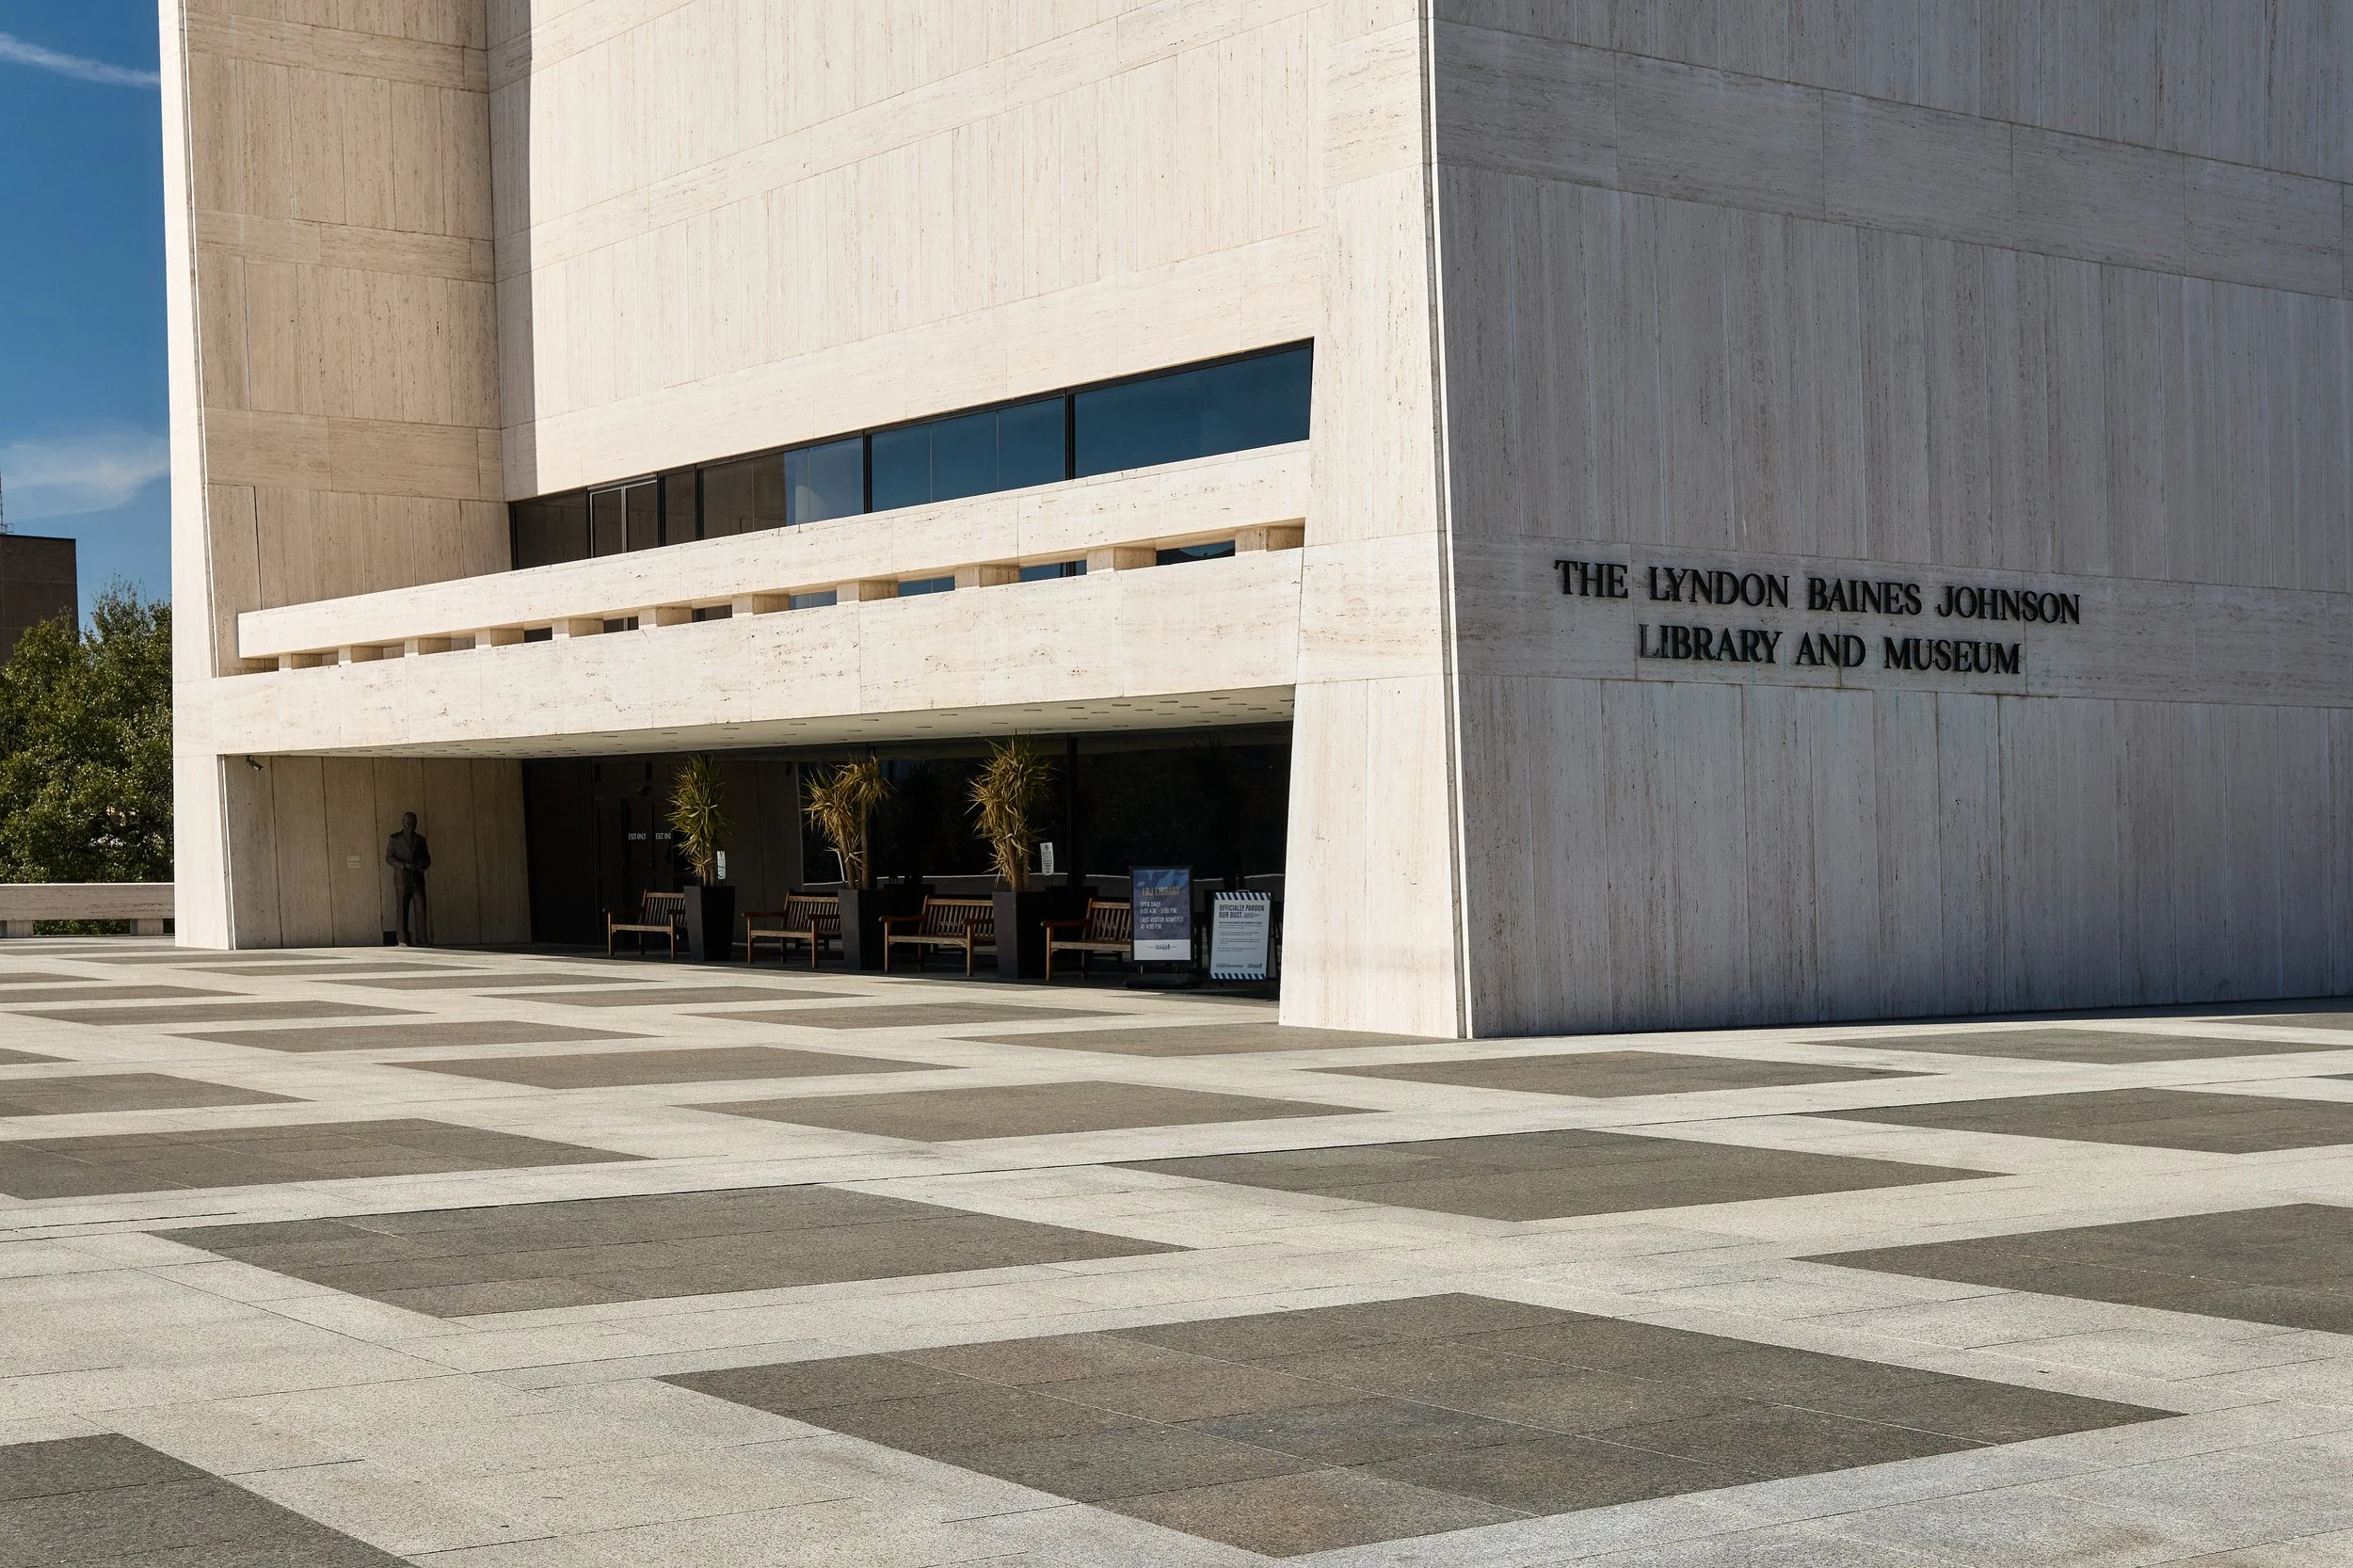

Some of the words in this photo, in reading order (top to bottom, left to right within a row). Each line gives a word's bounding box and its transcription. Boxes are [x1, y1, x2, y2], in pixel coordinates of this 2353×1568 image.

[1554, 560, 1628, 599] THE
[1648, 566, 1789, 608] LYNDON
[1807, 577, 1923, 616] BAINES
[1935, 585, 2080, 625] JOHNSON
[1638, 623, 1783, 664] LIBRARY
[1796, 632, 1866, 667] AND
[1883, 636, 2022, 674] MUSEUM
[1155, 887, 1180, 896] LIBRARY
